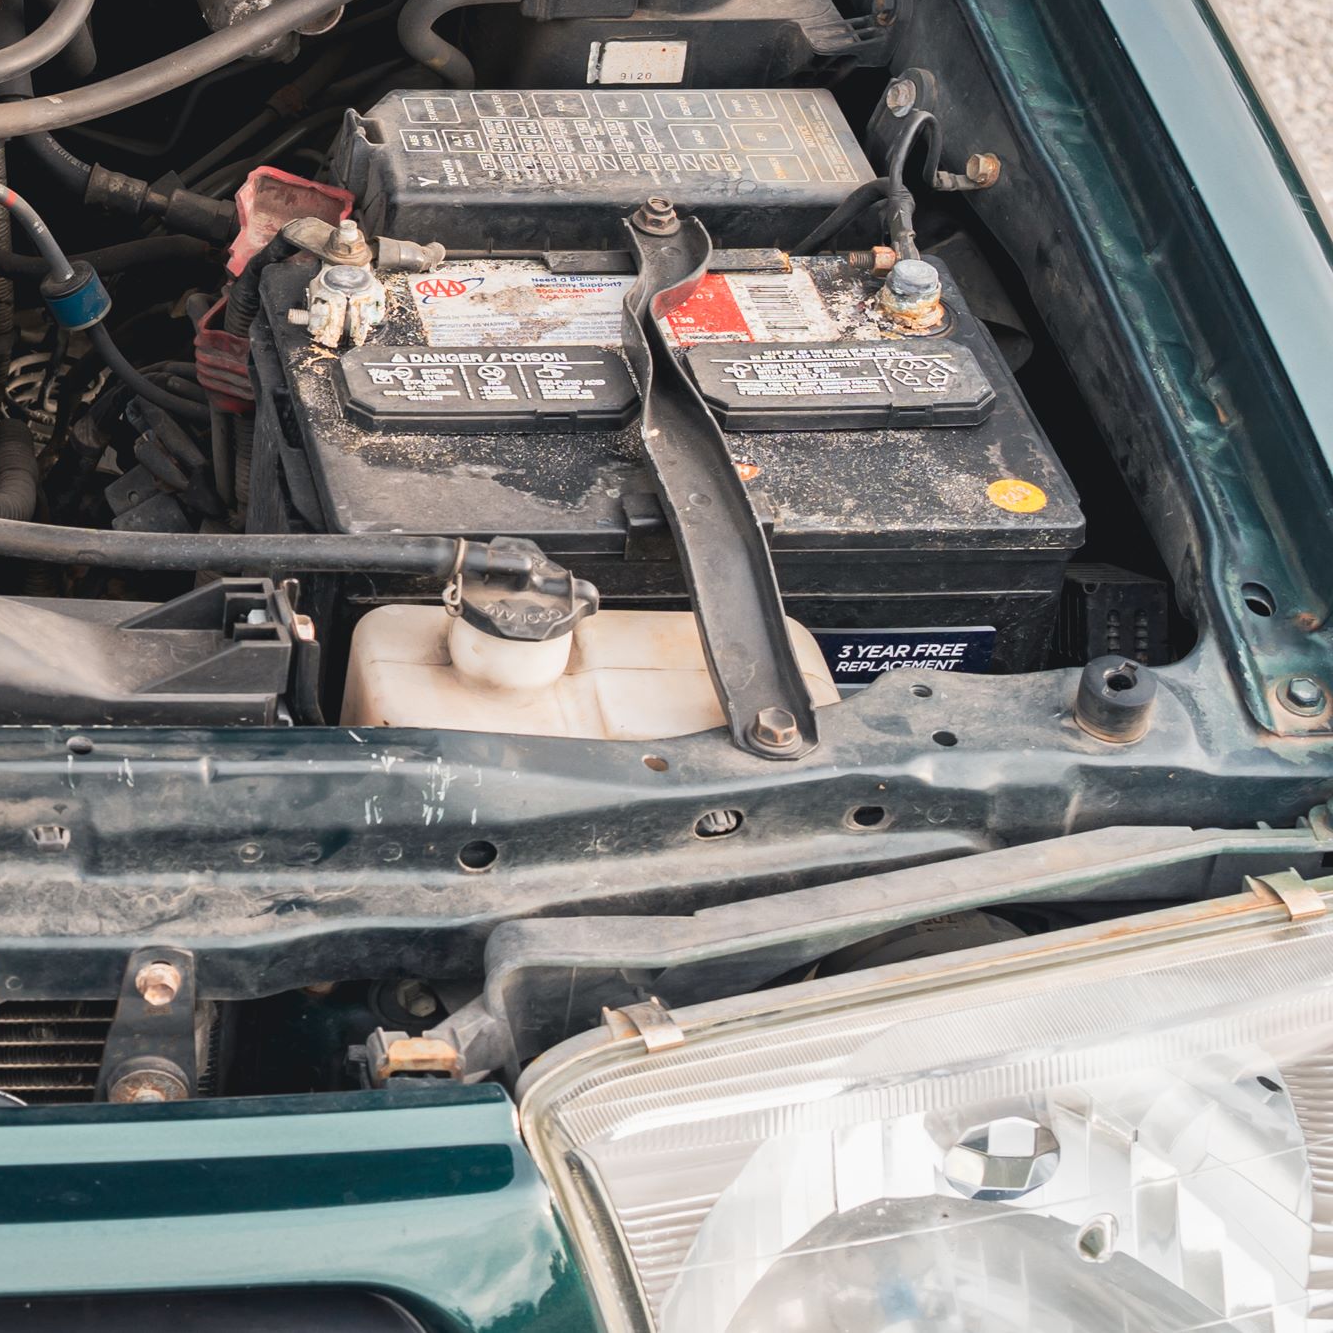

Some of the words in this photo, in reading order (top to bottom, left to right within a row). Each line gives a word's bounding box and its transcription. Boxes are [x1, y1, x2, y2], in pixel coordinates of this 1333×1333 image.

[620, 72, 652, 80] 9120
[424, 99, 439, 121] STARTER
[491, 94, 506, 116] HEATER
[409, 134, 420, 147] ABS
[451, 135, 463, 147] ALT
[692, 129, 706, 145] HEAD
[442, 159, 459, 186] TOYOTA
[417, 176, 439, 187] Y
[423, 281, 461, 296] AAA
[409, 354, 484, 363] DANGER
[501, 353, 568, 362] POISON
[837, 645, 853, 659] 3
[858, 644, 912, 659] YEAR
[912, 643, 968, 658] FREE
